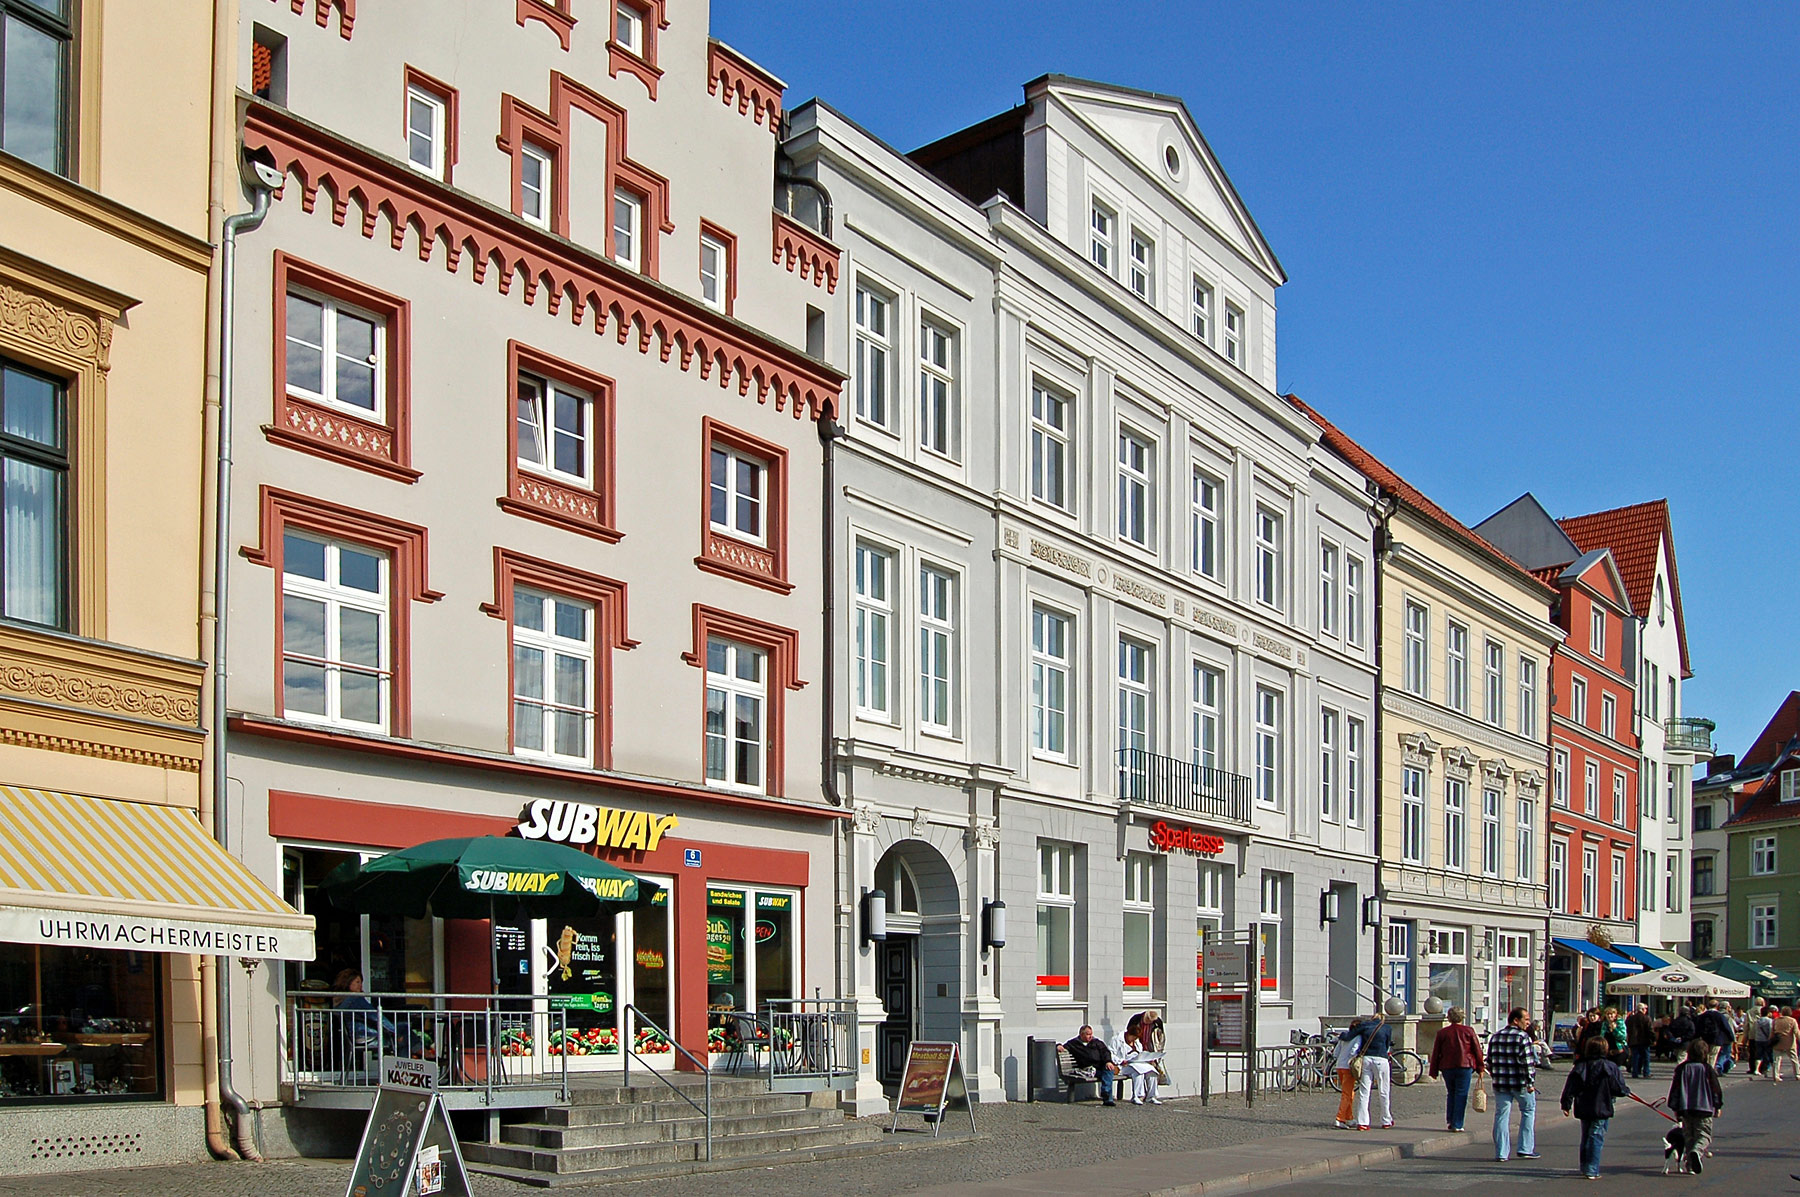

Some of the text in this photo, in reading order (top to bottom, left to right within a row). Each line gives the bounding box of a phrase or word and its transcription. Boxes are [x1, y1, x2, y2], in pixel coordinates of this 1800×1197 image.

[518, 799, 680, 851] SUBWAY
[1153, 821, 1224, 854] Sparkasse
[690, 850, 696, 859] 6
[465, 870, 560, 892] SUBWAY
[710, 890, 742, 899] Sandwiches
[758, 896, 788, 907] SUBWAY
[39, 919, 279, 953] UHRMACHERMEISTER
[755, 926, 773, 938] PEN
[571, 951, 605, 961] frisch hier
[1650, 985, 1700, 995] Franziskaner
[395, 1060, 424, 1072] JUWELIER
